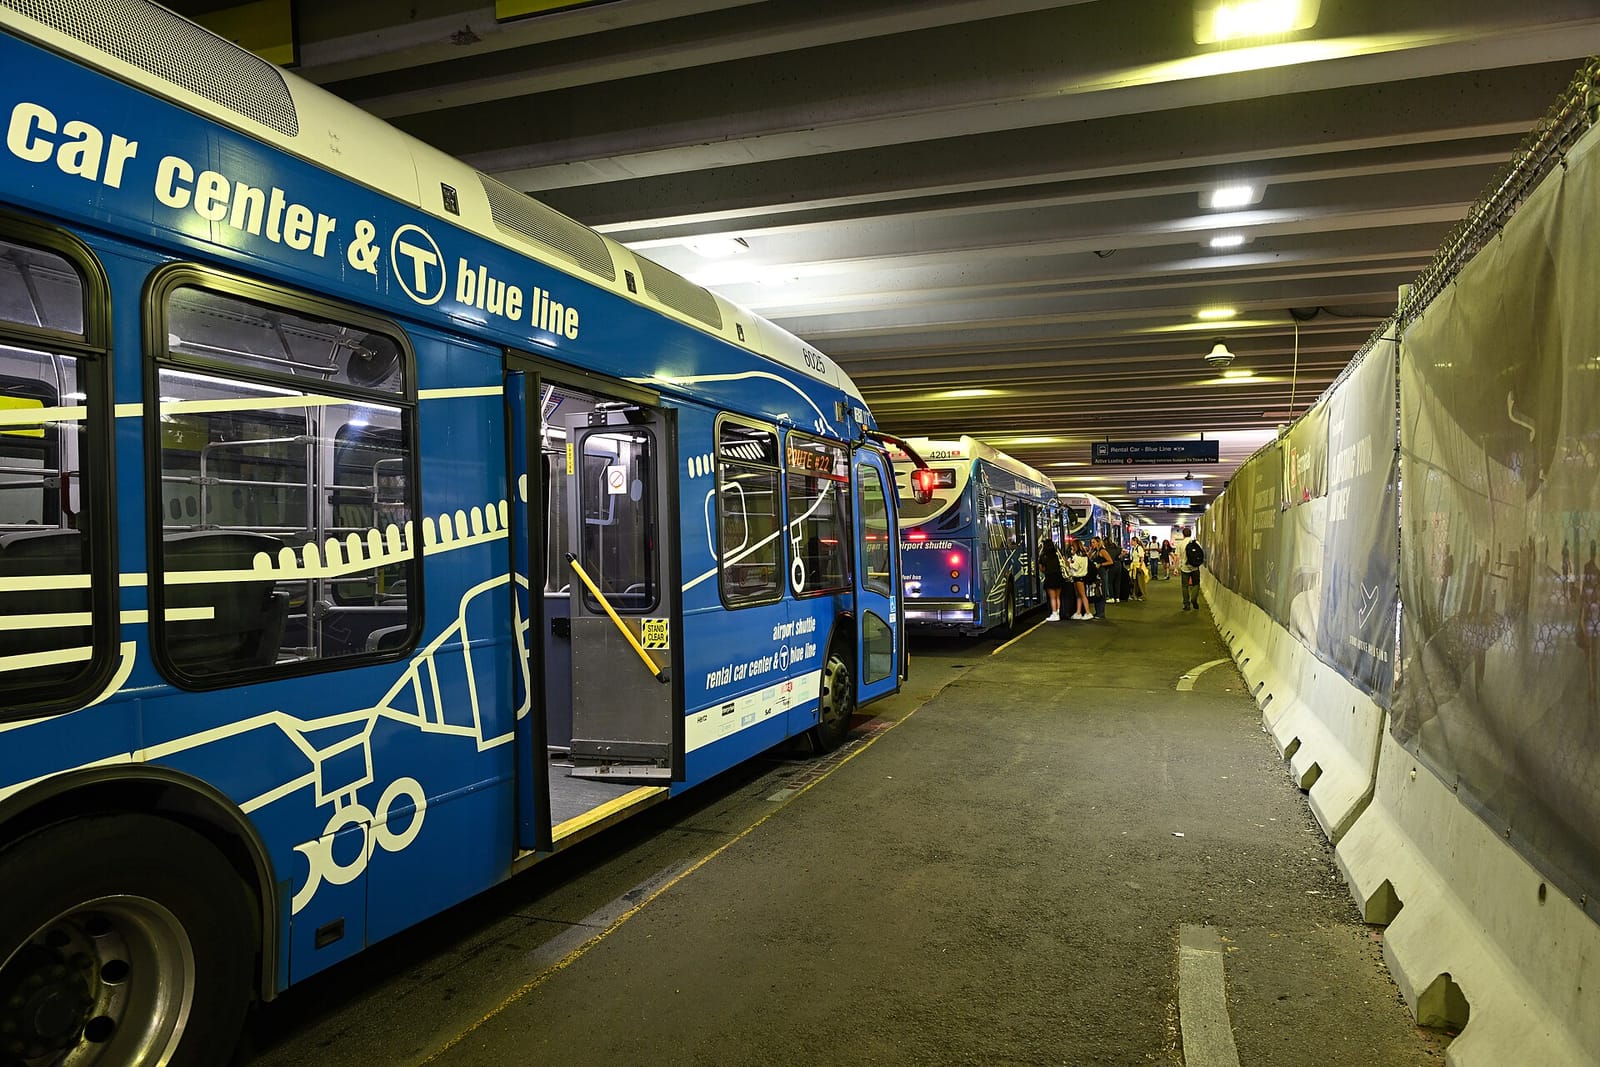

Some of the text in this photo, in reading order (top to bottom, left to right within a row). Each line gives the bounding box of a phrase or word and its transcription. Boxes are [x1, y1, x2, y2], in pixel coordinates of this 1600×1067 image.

[6, 102, 139, 188] car
[154, 155, 337, 257] center
[347, 219, 380, 275] &
[456, 257, 522, 321] blue
[531, 286, 580, 341] line
[802, 348, 826, 374] 6025
[787, 447, 829, 472] ROUTE #22
[930, 450, 951, 459] 4201
[899, 541, 923, 551] irport
[924, 540, 953, 550] shuttle
[647, 624, 664, 632] STAND
[647, 633, 664, 641] CLEAR
[772, 616, 816, 641] airport shuttle
[706, 664, 732, 690] rental
[733, 665, 748, 681] car
[748, 656, 773, 677] center
[773, 652, 779, 670] &
[789, 646, 804, 665] blue
[804, 642, 816, 660] line
